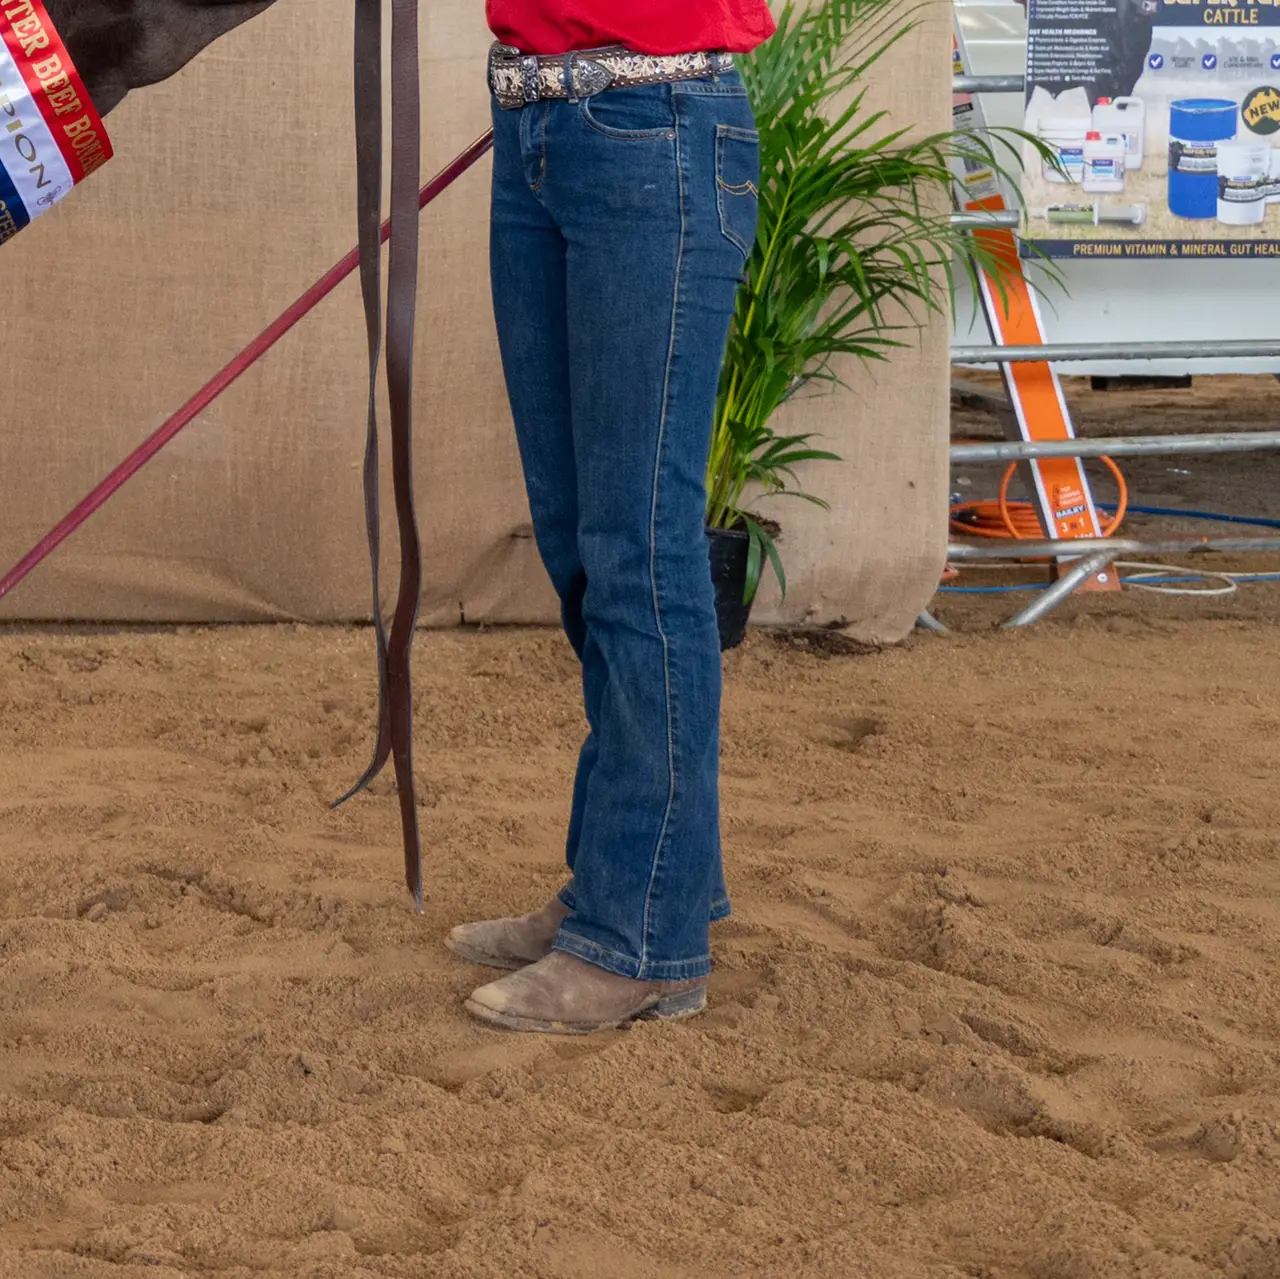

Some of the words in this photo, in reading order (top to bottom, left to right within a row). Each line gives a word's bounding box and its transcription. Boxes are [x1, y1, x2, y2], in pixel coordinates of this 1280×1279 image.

[1203, 8, 1259, 24] CATTLE
[32, 53, 83, 116] BEEF
[1249, 100, 1280, 119] NEW
[1073, 243, 1122, 256] PREMIUM
[1125, 243, 1167, 256] VITAMIN
[1170, 244, 1178, 255] &
[1182, 244, 1227, 255] MINERAL
[1230, 244, 1252, 255] GUT
[1254, 244, 1280, 255] HEAL
[1055, 505, 1085, 519] BAILEY
[1061, 522, 1069, 533] 3
